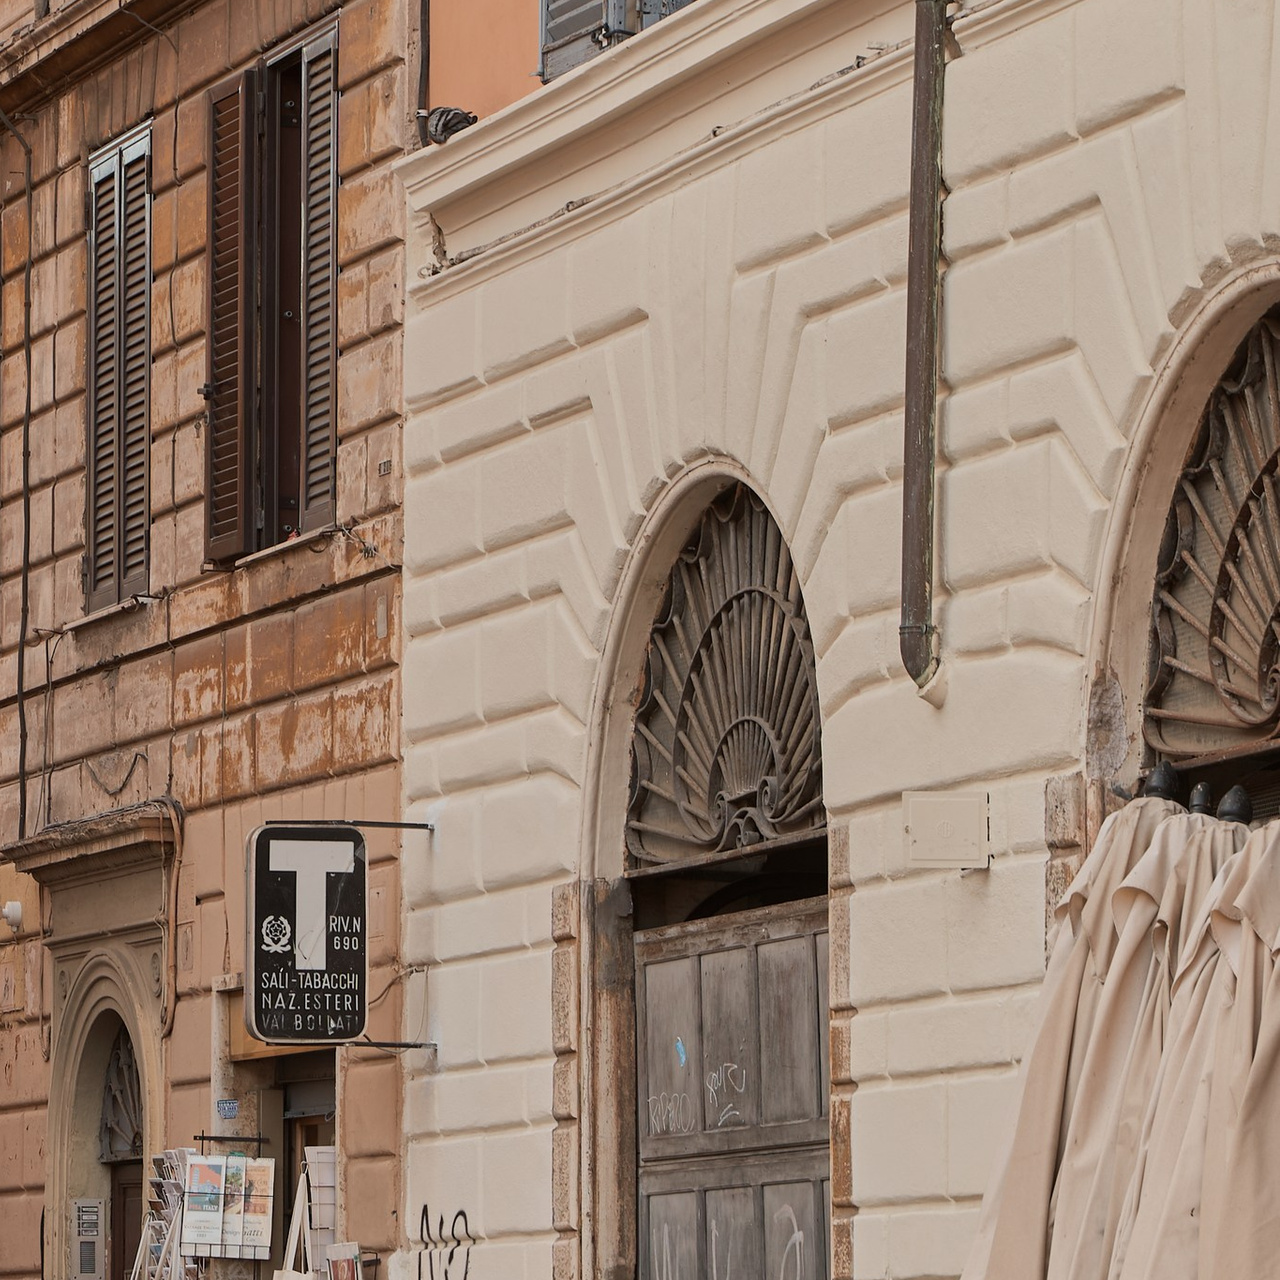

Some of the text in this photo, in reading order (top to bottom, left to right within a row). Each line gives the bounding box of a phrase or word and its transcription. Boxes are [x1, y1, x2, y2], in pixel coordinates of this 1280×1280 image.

[269, 840, 355, 970] T
[334, 936, 359, 950] 690
[262, 993, 359, 1011] NAZ. ESTERI
